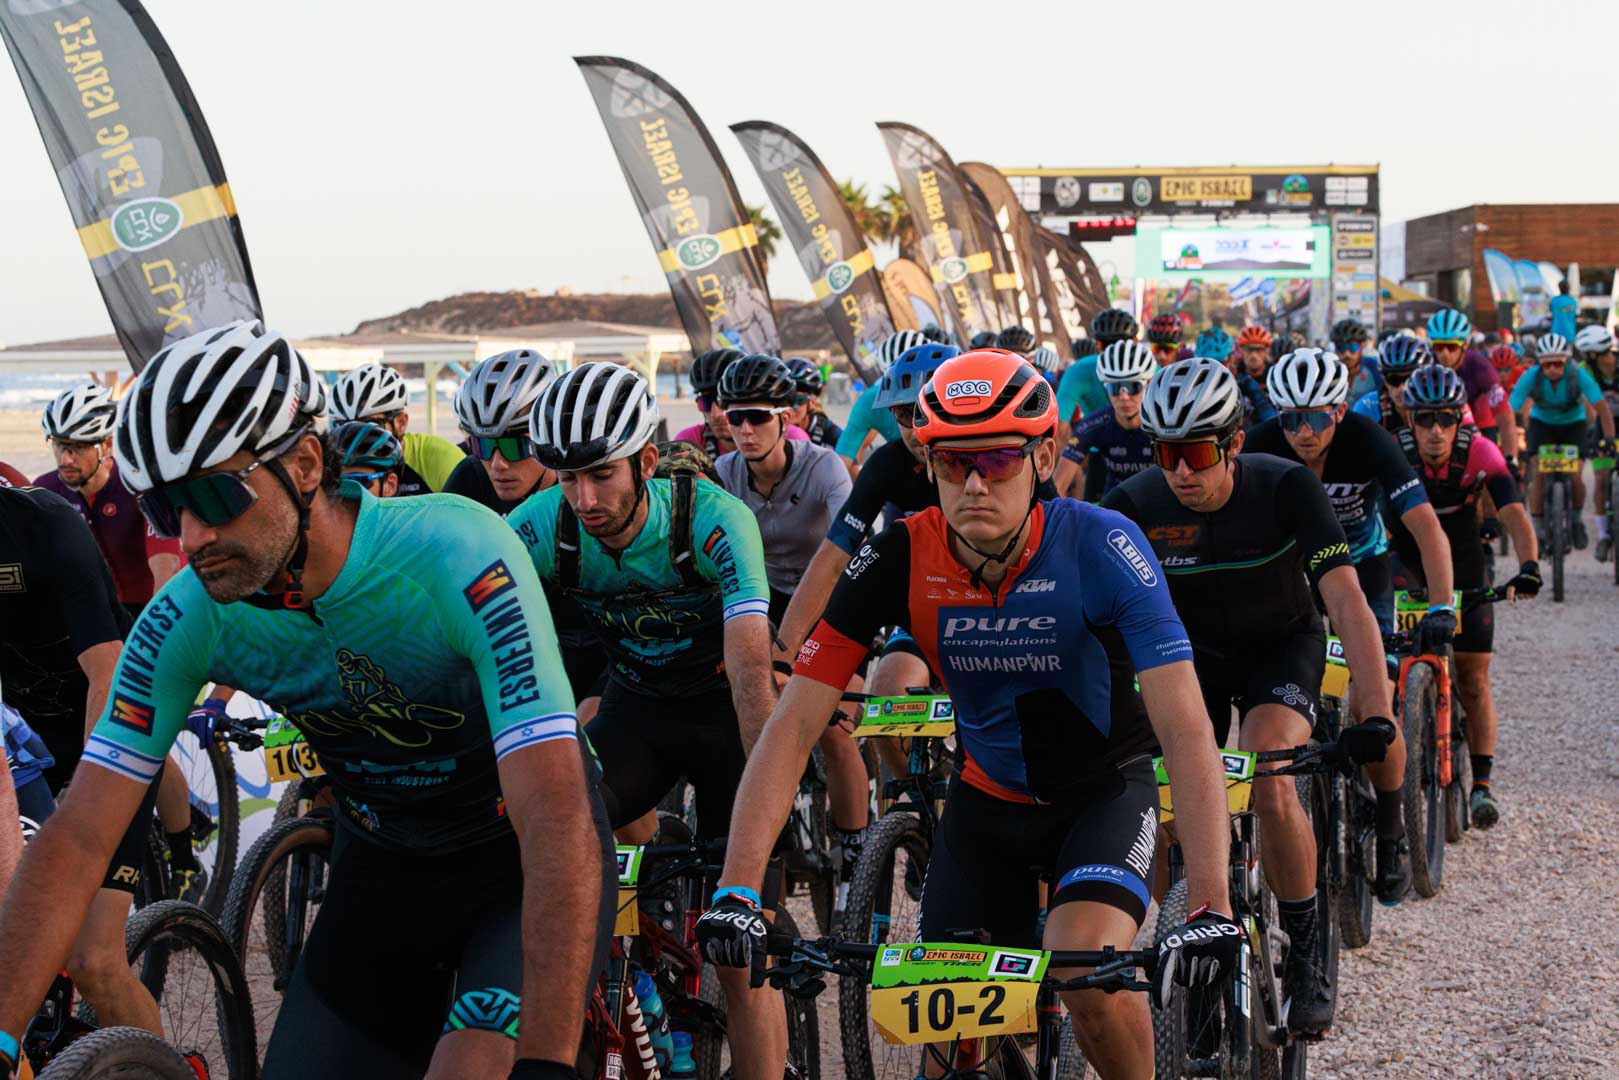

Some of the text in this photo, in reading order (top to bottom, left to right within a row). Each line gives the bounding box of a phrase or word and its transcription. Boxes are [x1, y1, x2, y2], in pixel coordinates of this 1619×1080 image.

[948, 382, 990, 396] MSG
[1149, 525, 1201, 540] CST
[851, 551, 880, 580] watch
[1111, 534, 1154, 582] ABUS
[1015, 578, 1057, 593] KTM
[944, 616, 1057, 638] pure
[119, 594, 185, 698] INVERSE
[943, 637, 1057, 648] encapsulations
[483, 596, 540, 713] INVERSE
[1072, 866, 1125, 878] pure
[926, 951, 983, 961] EPIC ISRAEL
[900, 985, 1006, 1033] 10-2
